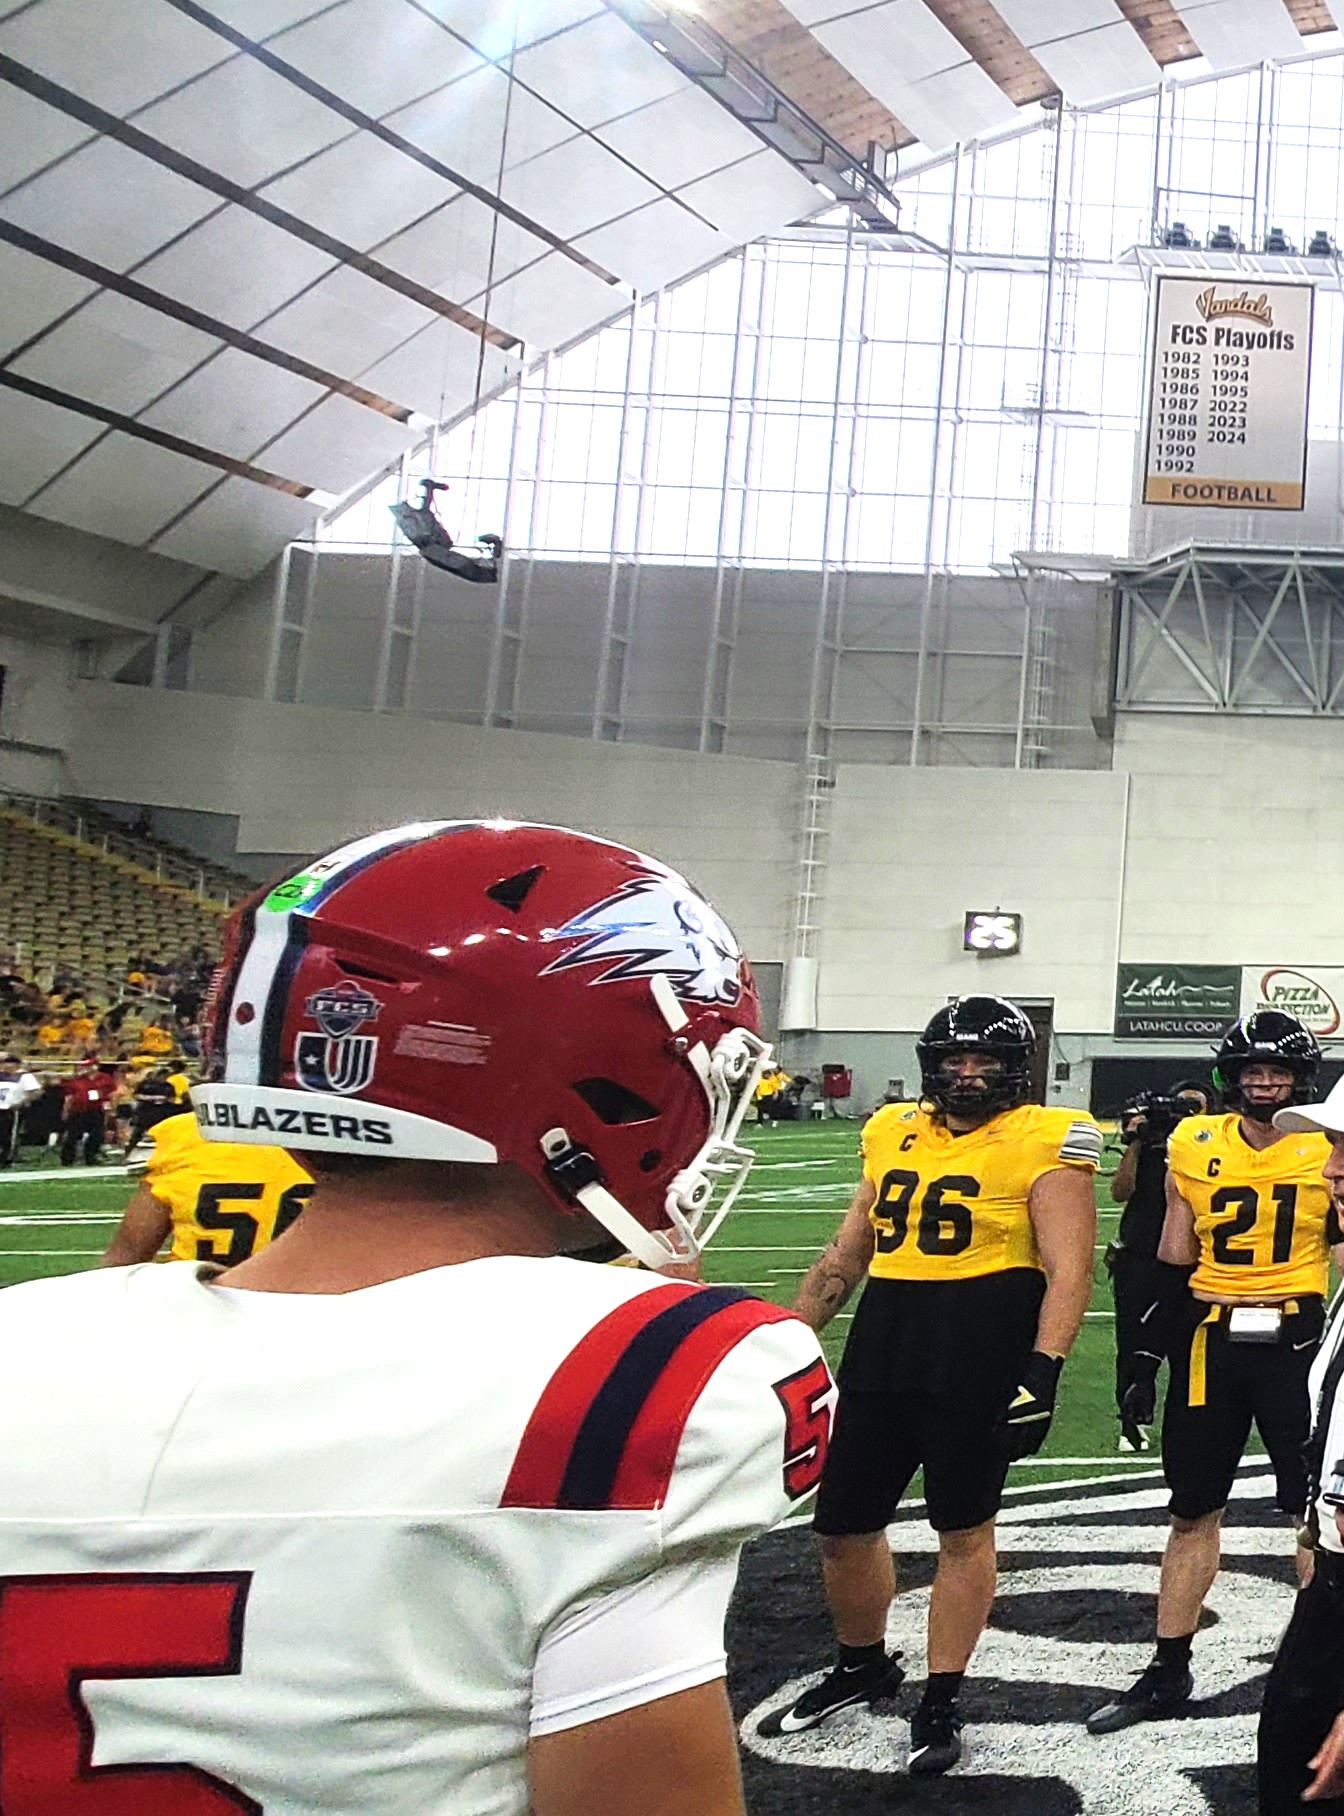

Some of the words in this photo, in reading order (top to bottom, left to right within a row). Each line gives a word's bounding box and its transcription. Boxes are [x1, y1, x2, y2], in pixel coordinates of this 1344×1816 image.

[1195, 286, 1274, 328] Vandals
[1170, 324, 1208, 346] FCS
[1213, 327, 1295, 351] Playoffs
[1162, 351, 1201, 365] 1982
[1212, 353, 1250, 367] 1993
[1161, 366, 1200, 380] 1985
[1211, 368, 1249, 383] 1994
[1160, 381, 1199, 396] 1986
[1210, 384, 1248, 398] 1995
[1159, 397, 1198, 412] 1987
[1208, 399, 1247, 414] 2022
[1158, 412, 1197, 427] 1988
[1207, 414, 1247, 429] 2023
[1157, 428, 1197, 442] 1989
[1207, 430, 1246, 445] 2024
[1156, 443, 1195, 457] 1990
[1155, 459, 1194, 473] 1992
[1170, 482, 1277, 503] FOOTBALL
[1272, 986, 1320, 1001] PIZZA
[315, 1000, 369, 1015] FCS
[1130, 1020, 1223, 1034] LATAHCU.COOP
[900, 1134, 917, 1152] C
[1207, 1158, 1221, 1177] C
[876, 1169, 980, 1256] 96
[1209, 1183, 1298, 1266] 21
